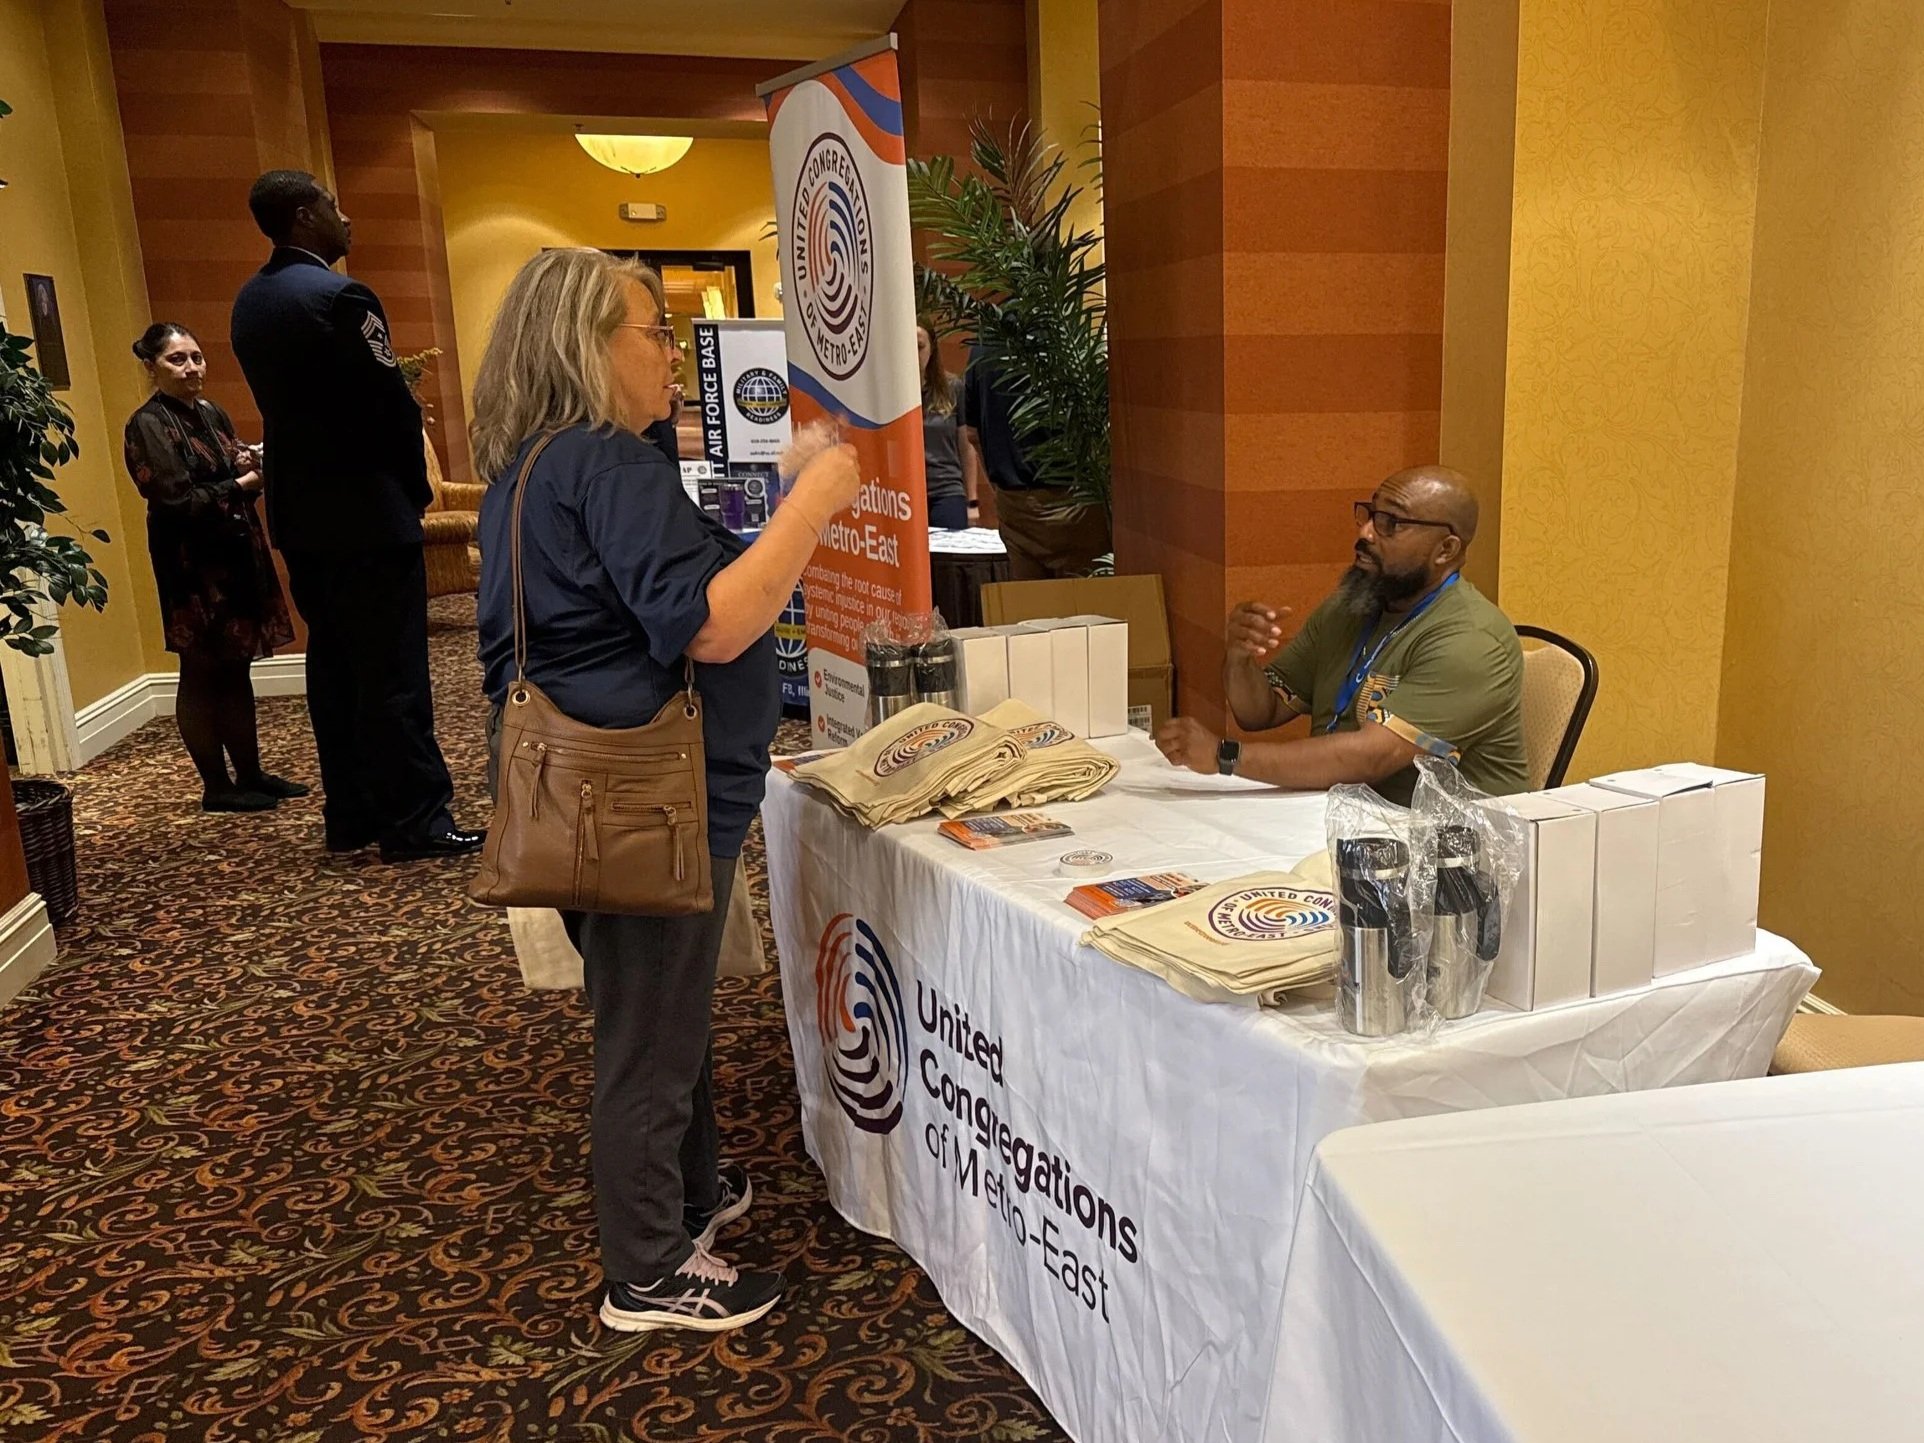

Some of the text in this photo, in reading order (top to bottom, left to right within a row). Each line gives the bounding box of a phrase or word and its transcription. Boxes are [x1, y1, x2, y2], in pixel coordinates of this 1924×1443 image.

[796, 148, 869, 281] UNITED CONGREGATIONS
[699, 326, 717, 369] BASE
[806, 300, 867, 366] OF METRO-EAST
[736, 370, 759, 394] MILITARY
[769, 371, 788, 394] FAMILY
[703, 372, 721, 425] FORCE
[746, 412, 782, 423] READINESS
[708, 429, 724, 457] AIR
[841, 571, 852, 590] the
[854, 578, 869, 595] root
[871, 583, 895, 603] cause
[815, 604, 838, 629] uniting
[840, 613, 865, 634] people
[866, 598, 873, 616] in
[875, 606, 891, 621] our
[824, 668, 865, 697] Environmental
[825, 684, 846, 703] Justice
[826, 714, 855, 739] Integrated
[1221, 901, 1238, 913] OF
[1240, 891, 1298, 902] UNITED
[1217, 912, 1285, 939] METRO-EAST
[916, 979, 1004, 1088] United
[919, 1047, 1139, 1264] Congregations
[924, 1121, 1111, 1324] of Metro-East
